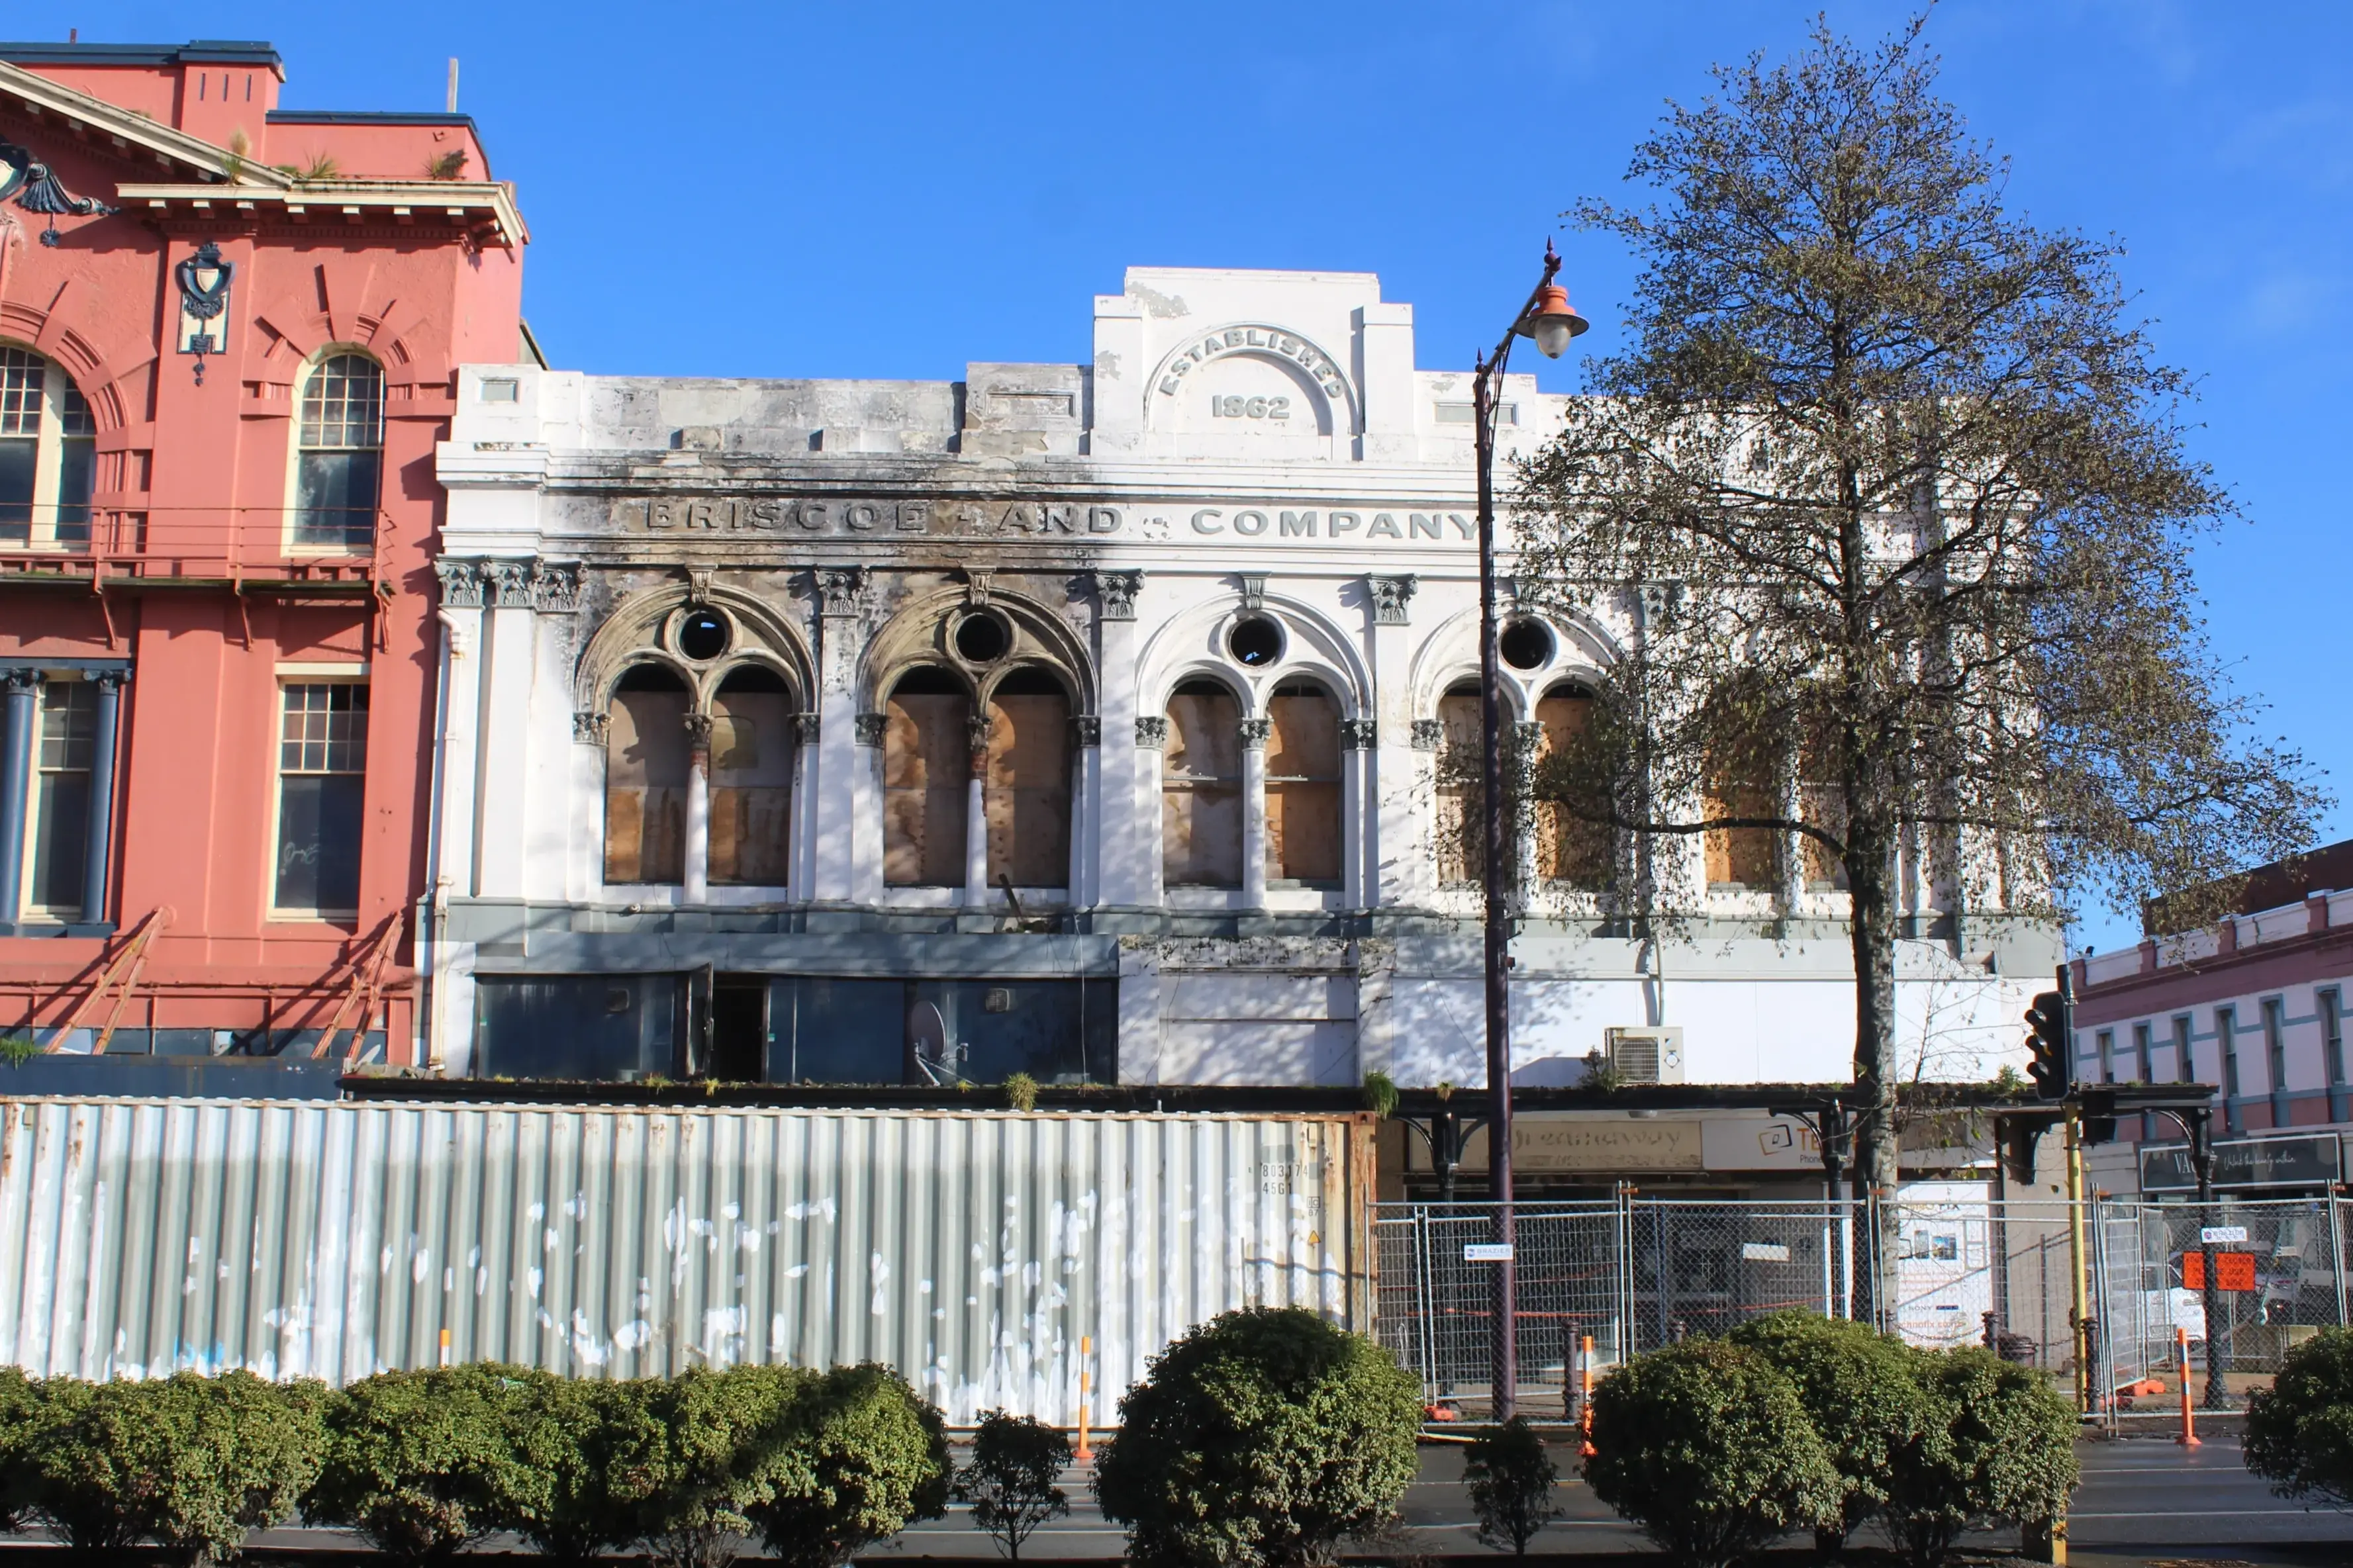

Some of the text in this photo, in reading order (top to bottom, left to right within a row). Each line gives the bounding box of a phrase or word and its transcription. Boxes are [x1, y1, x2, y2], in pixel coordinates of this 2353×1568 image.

[1158, 329, 1345, 398] ESTABLISHED
[1212, 394, 1290, 419] 1862
[646, 501, 1480, 540] BRISCOE AND COMPANY
[1263, 1164, 1308, 1177] 803174
[1263, 1182, 1292, 1195] 45G1
